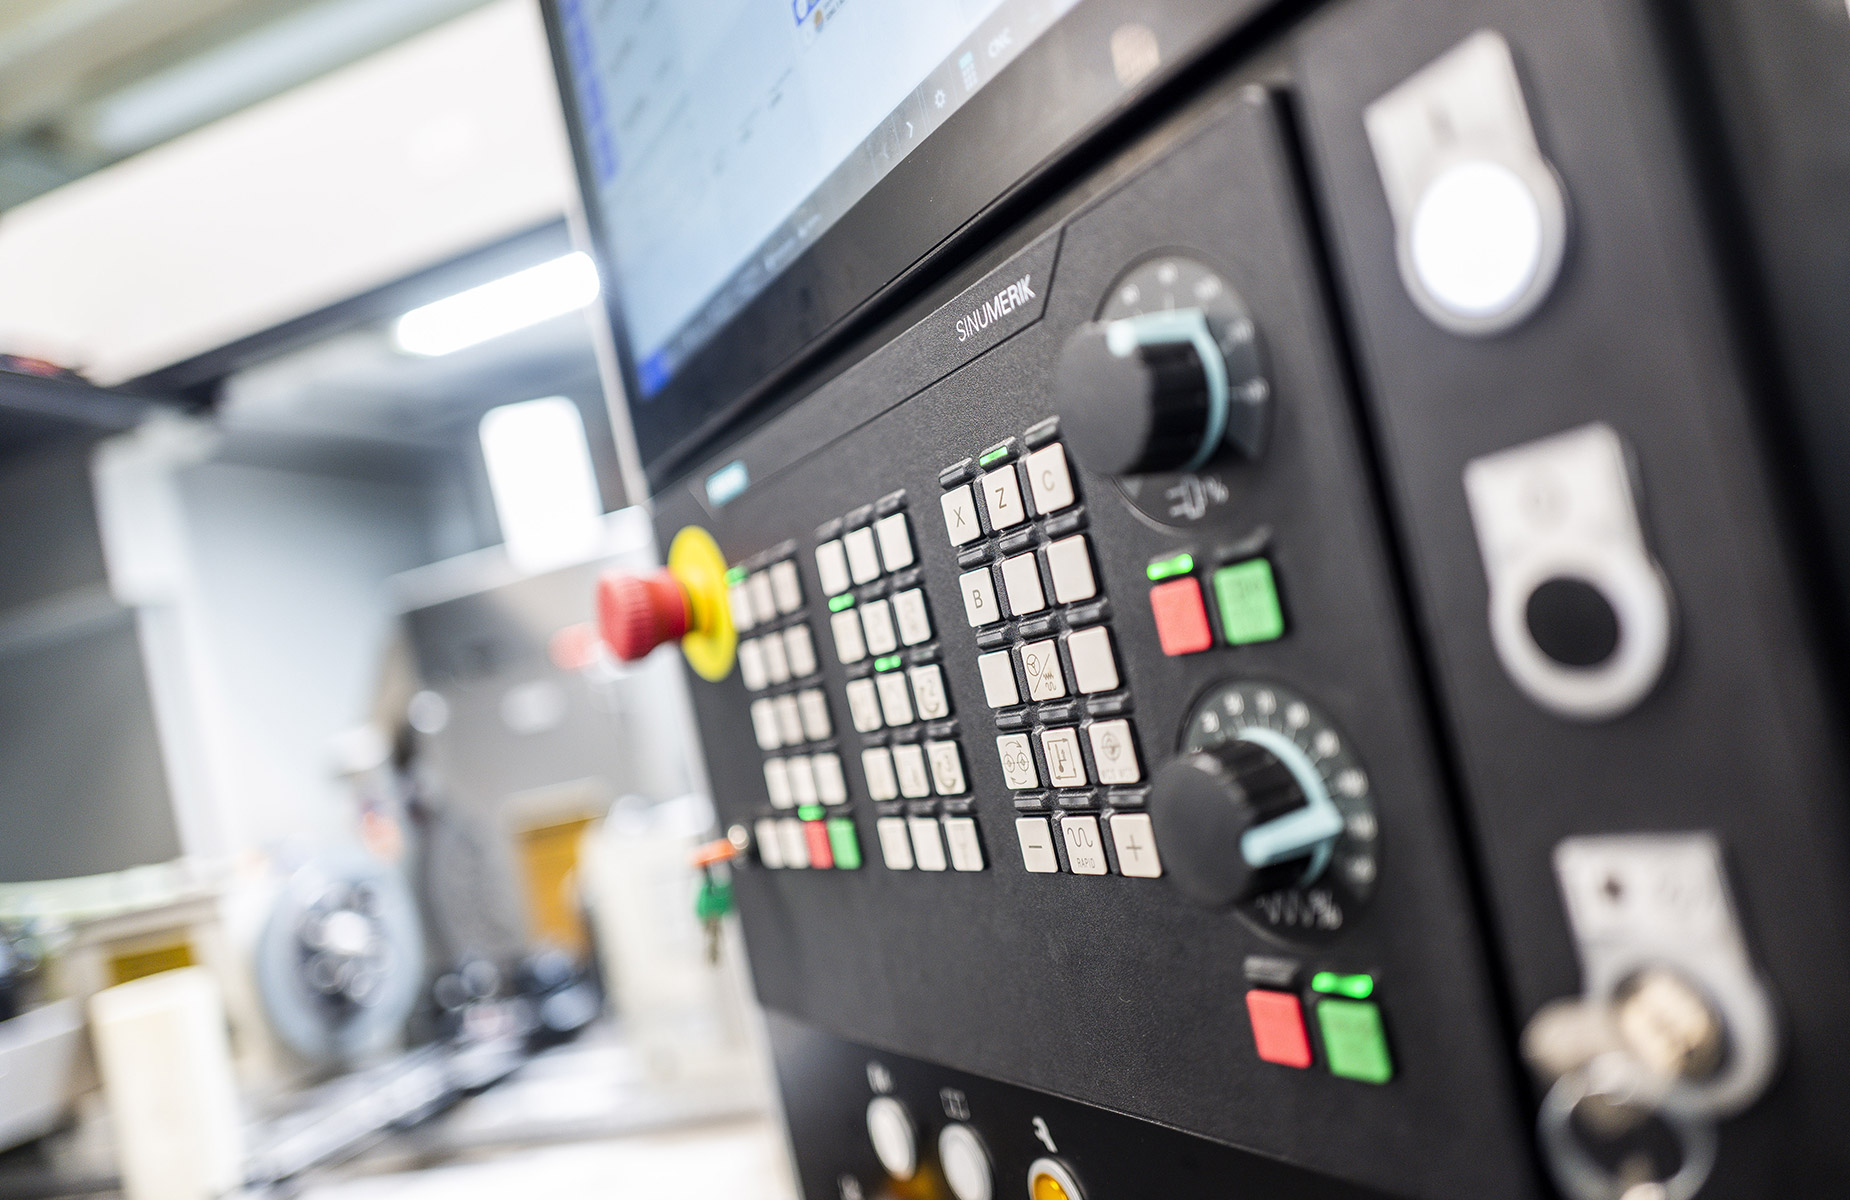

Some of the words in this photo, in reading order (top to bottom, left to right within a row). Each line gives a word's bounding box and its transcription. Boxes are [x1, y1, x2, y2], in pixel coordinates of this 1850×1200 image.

[956, 274, 1036, 341] SINUMERIK
[1042, 470, 1056, 491] C
[995, 487, 1008, 510] Z
[953, 506, 966, 528] X
[972, 589, 984, 609] B
[1076, 857, 1096, 869] RAPID
